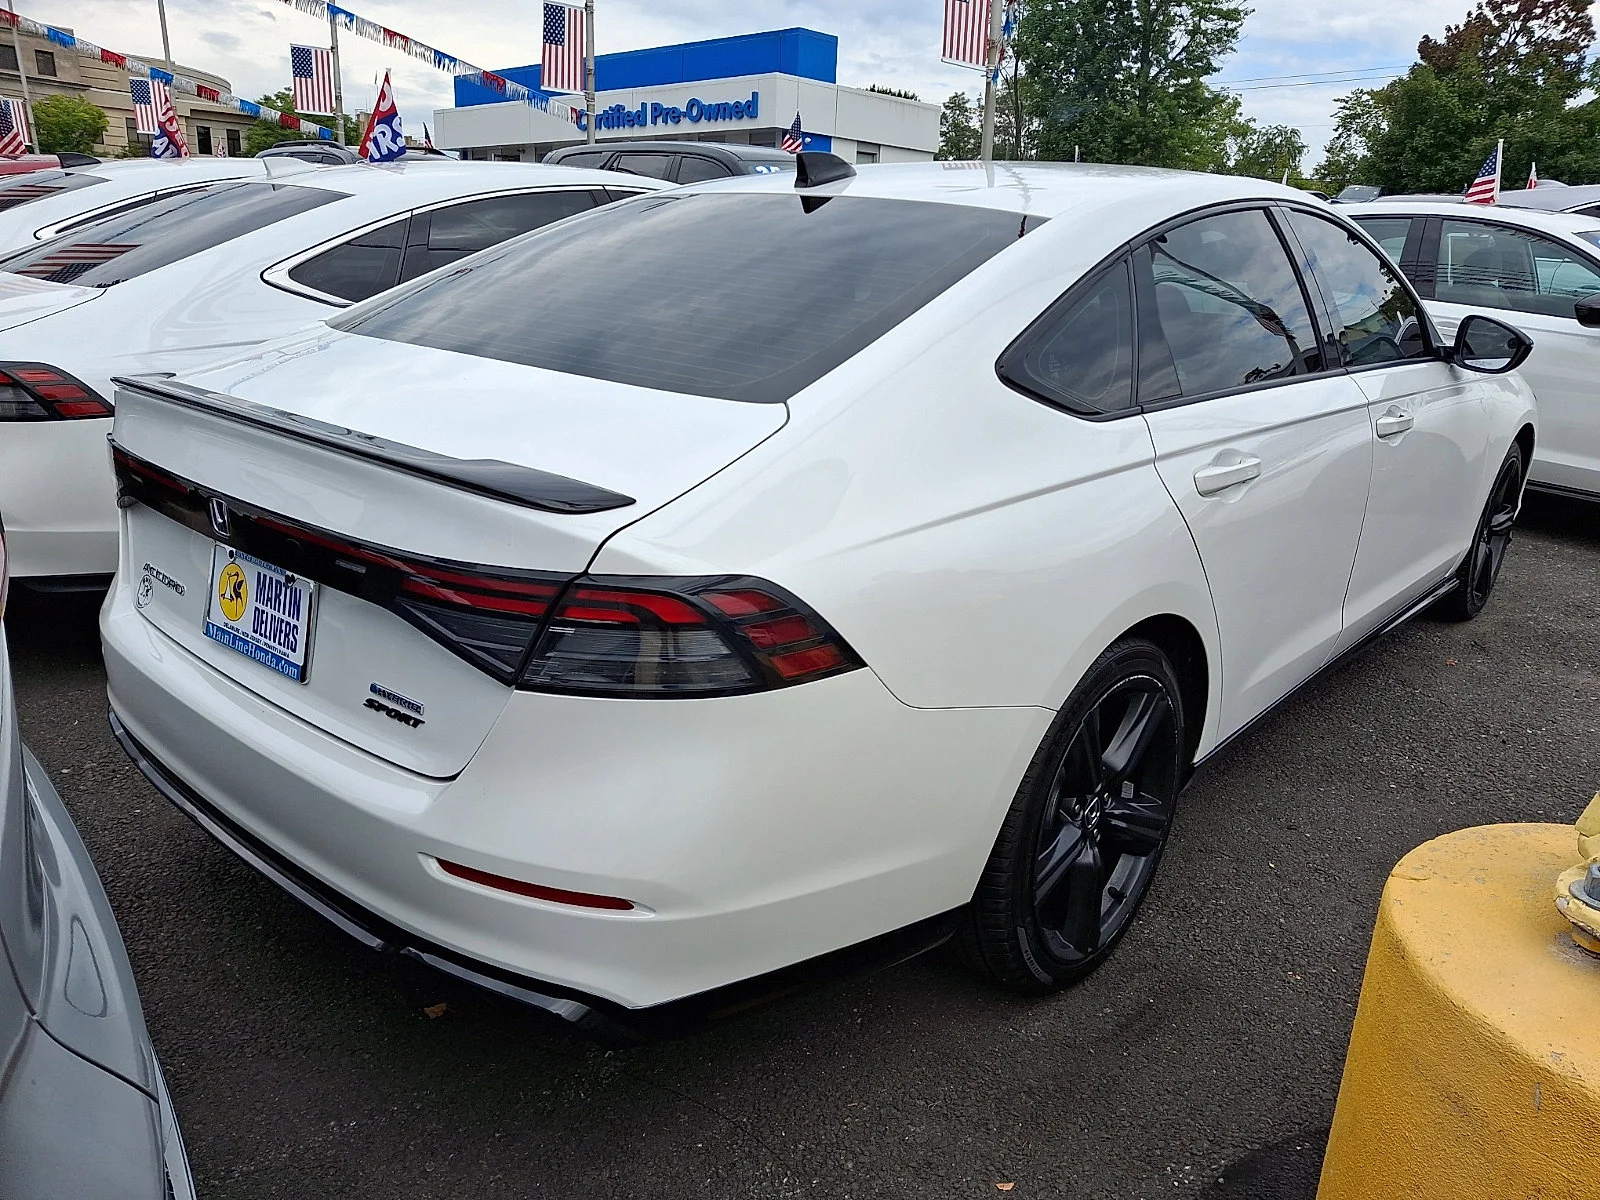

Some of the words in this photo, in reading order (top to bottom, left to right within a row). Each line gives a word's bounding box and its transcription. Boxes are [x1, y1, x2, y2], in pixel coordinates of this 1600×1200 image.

[577, 102, 647, 131] Crtified
[651, 91, 759, 126] Pre-Owned
[254, 570, 302, 622] MARTIN
[206, 622, 298, 679] MainLineHonda.com
[252, 605, 300, 654] DELIVERS
[363, 698, 425, 728] SPORT
